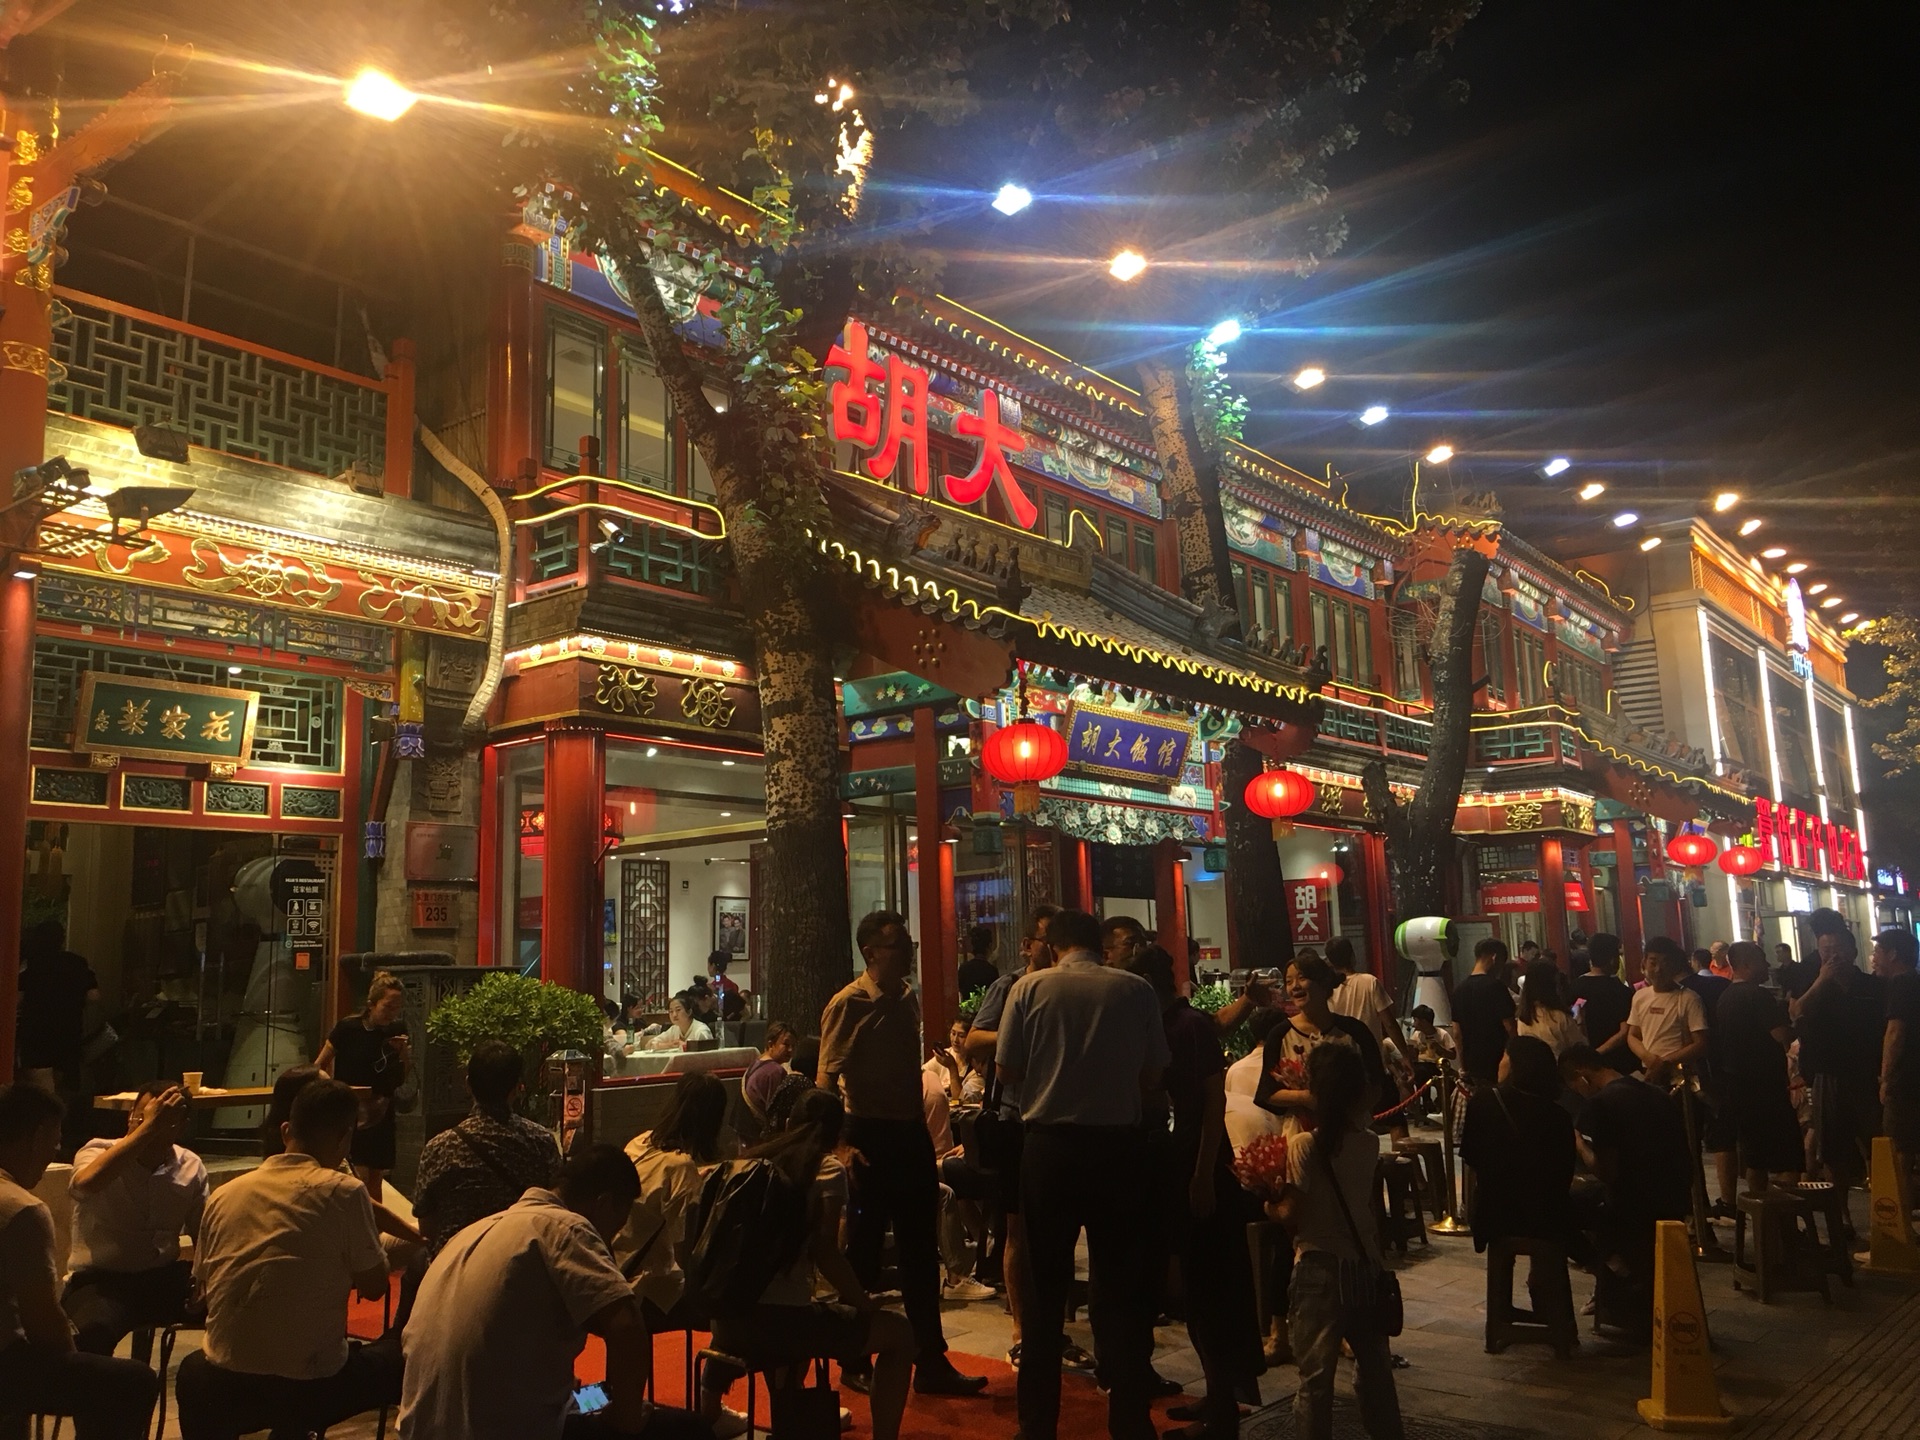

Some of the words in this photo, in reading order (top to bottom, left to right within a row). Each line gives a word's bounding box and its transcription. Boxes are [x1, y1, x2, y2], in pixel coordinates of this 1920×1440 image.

[824, 321, 1039, 530] 胡大
[426, 907, 447, 921] 235
[1294, 885, 1319, 933] 胡大
